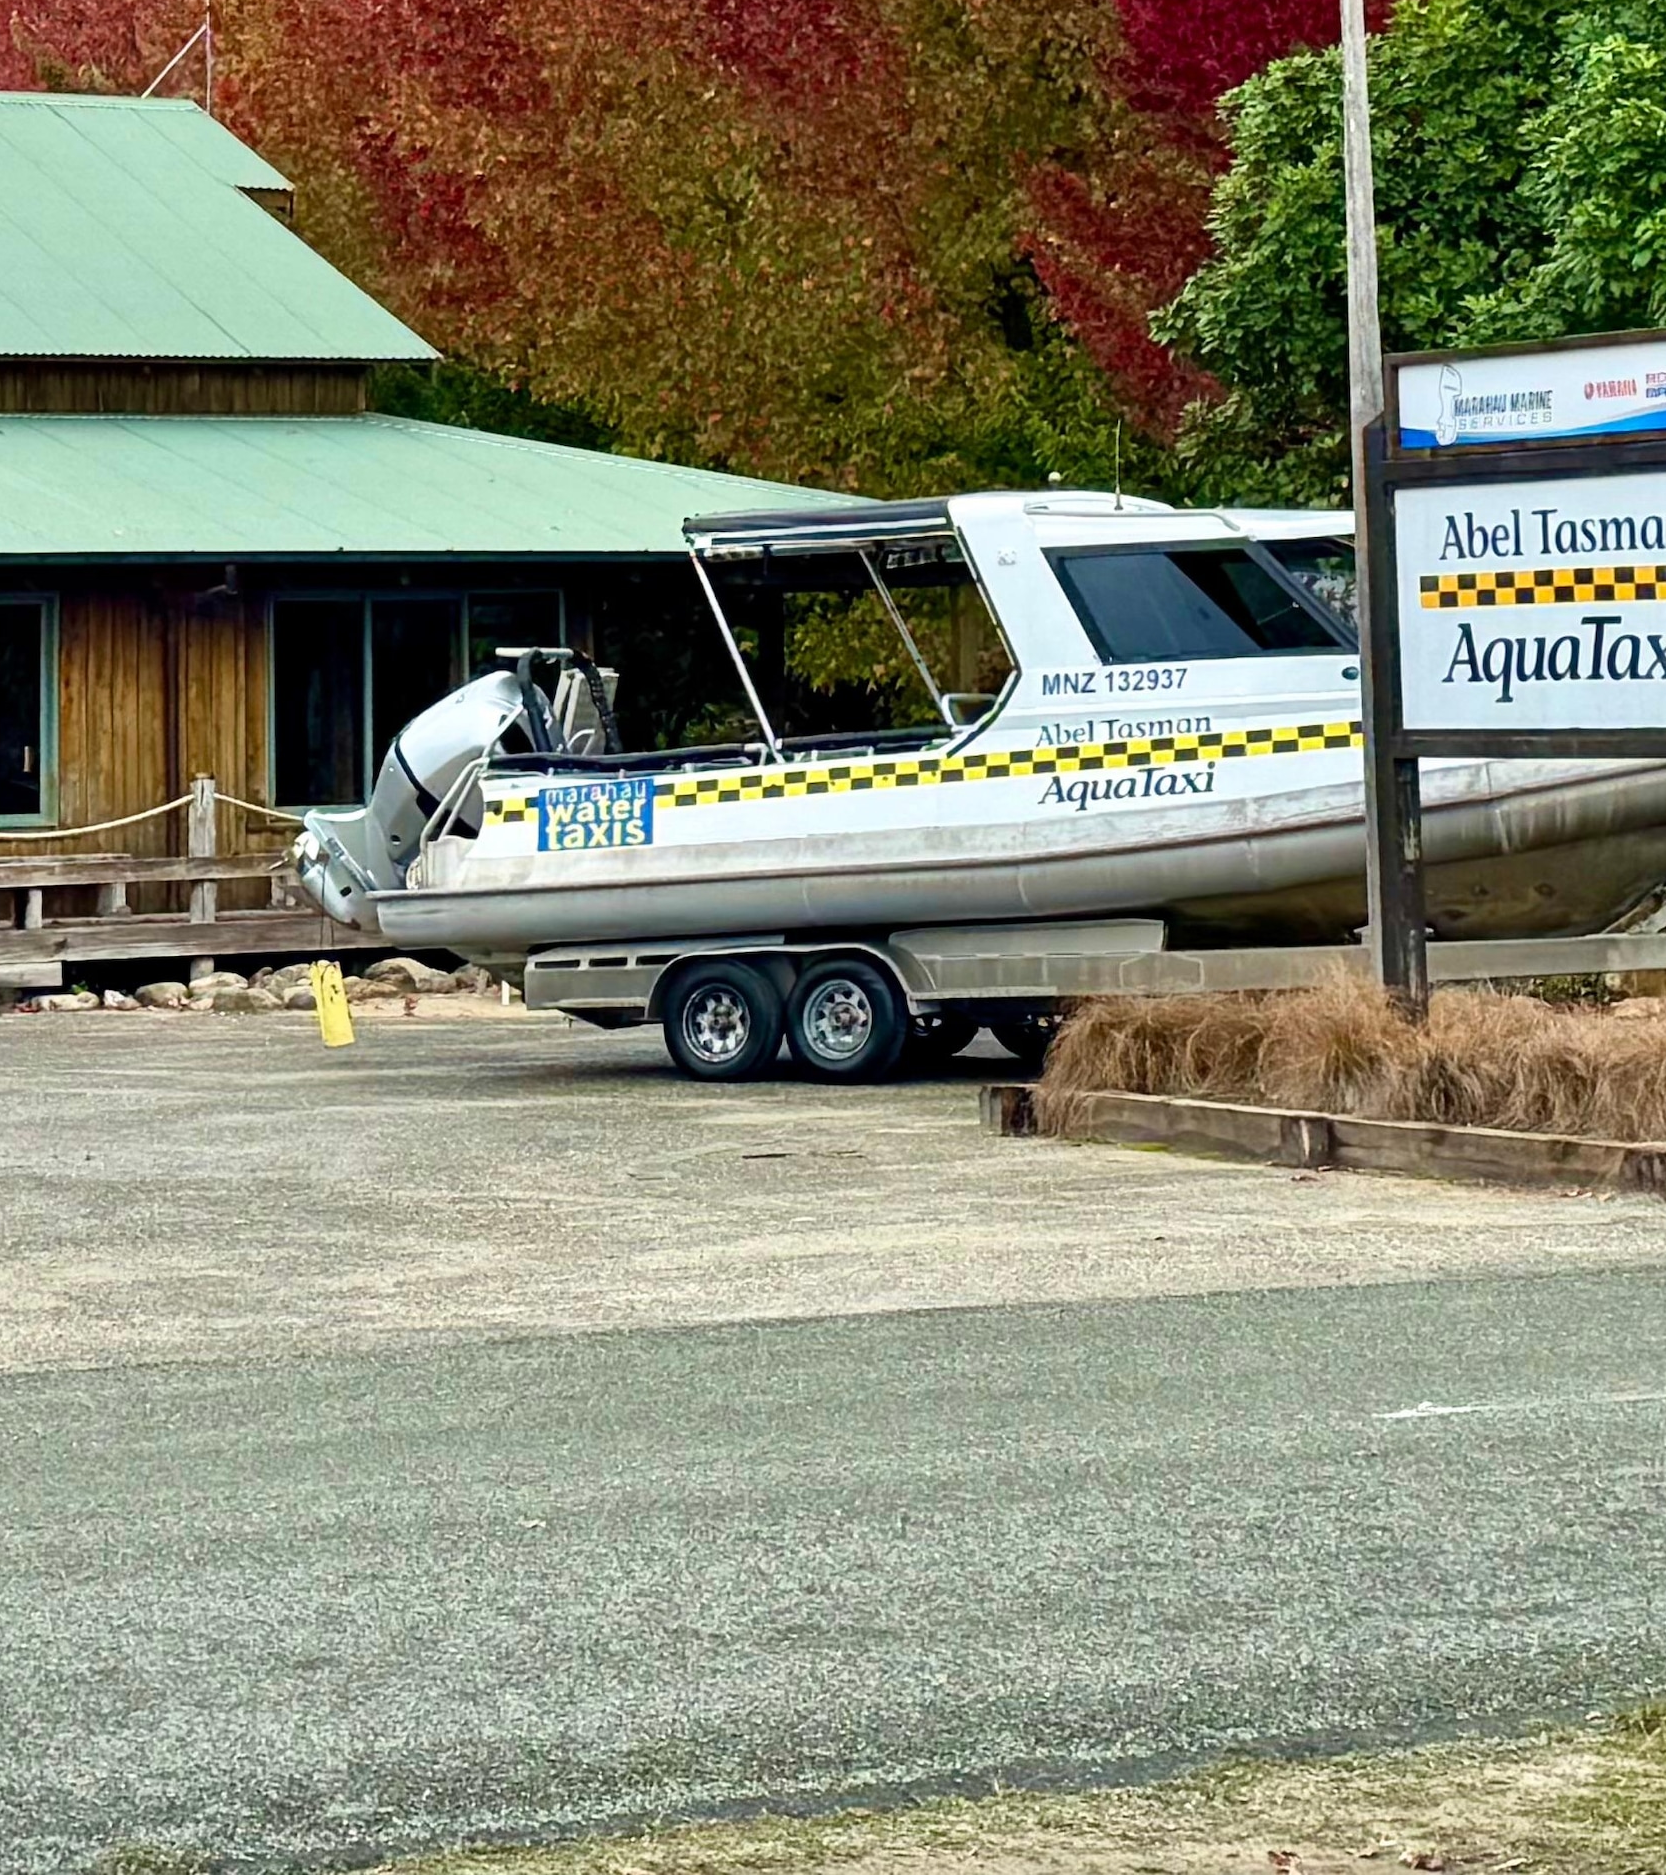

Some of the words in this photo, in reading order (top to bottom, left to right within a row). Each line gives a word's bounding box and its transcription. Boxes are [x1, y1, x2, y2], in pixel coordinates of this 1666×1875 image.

[1596, 378, 1637, 398] YAMAHA
[1454, 396, 1507, 417] MARAHAU
[1510, 390, 1553, 412] MARINE
[1458, 411, 1552, 430] SERVICES
[1439, 509, 1524, 561] Abel
[1042, 672, 1096, 695] MNZ
[1104, 668, 1188, 692] 132937
[1036, 720, 1094, 747] Abel
[1099, 716, 1211, 741] Tasman
[545, 781, 646, 805] marahau
[1037, 761, 1215, 812] AquaTaxi
[546, 796, 647, 823] water
[545, 818, 645, 850] taxis
